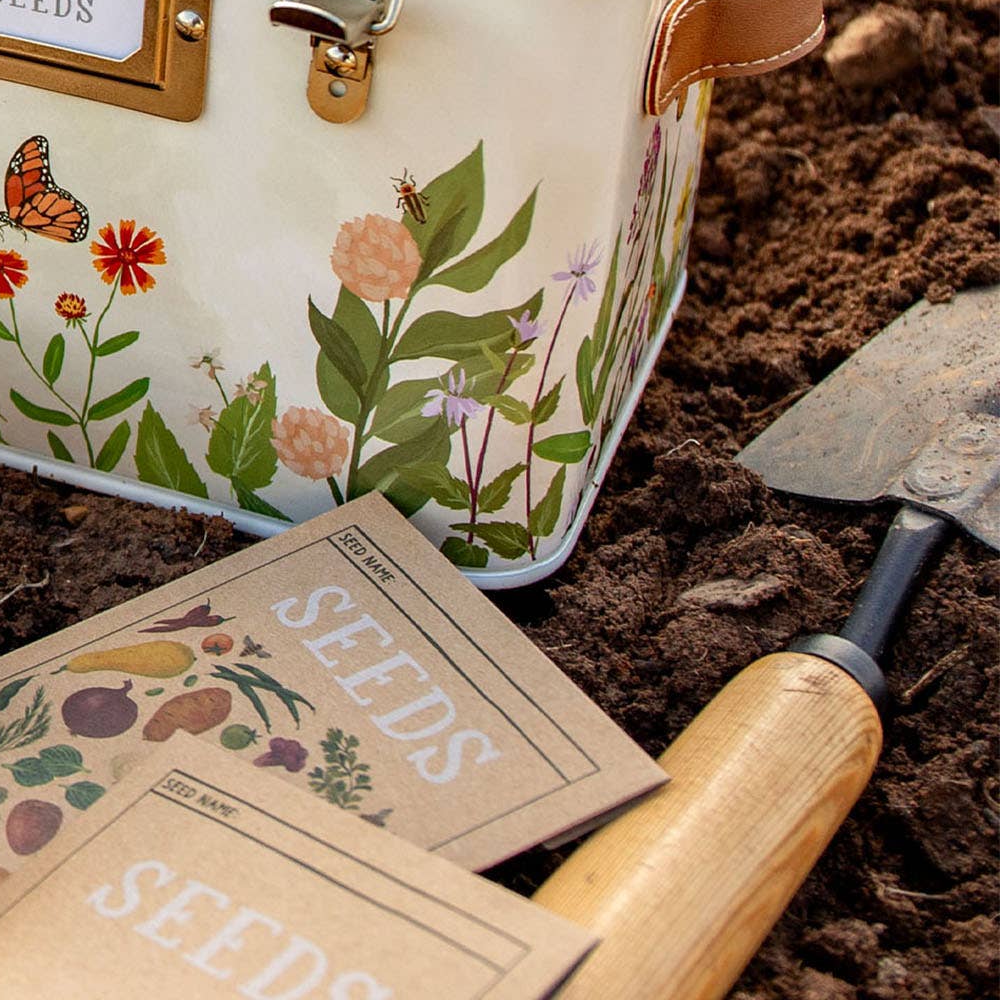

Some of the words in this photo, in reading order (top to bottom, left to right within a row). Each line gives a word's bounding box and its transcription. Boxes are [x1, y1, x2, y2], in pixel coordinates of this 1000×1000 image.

[338, 531, 368, 556] SEED
[362, 554, 397, 586] NAME:
[270, 585, 501, 785] SEEDS
[161, 778, 198, 799] SEED
